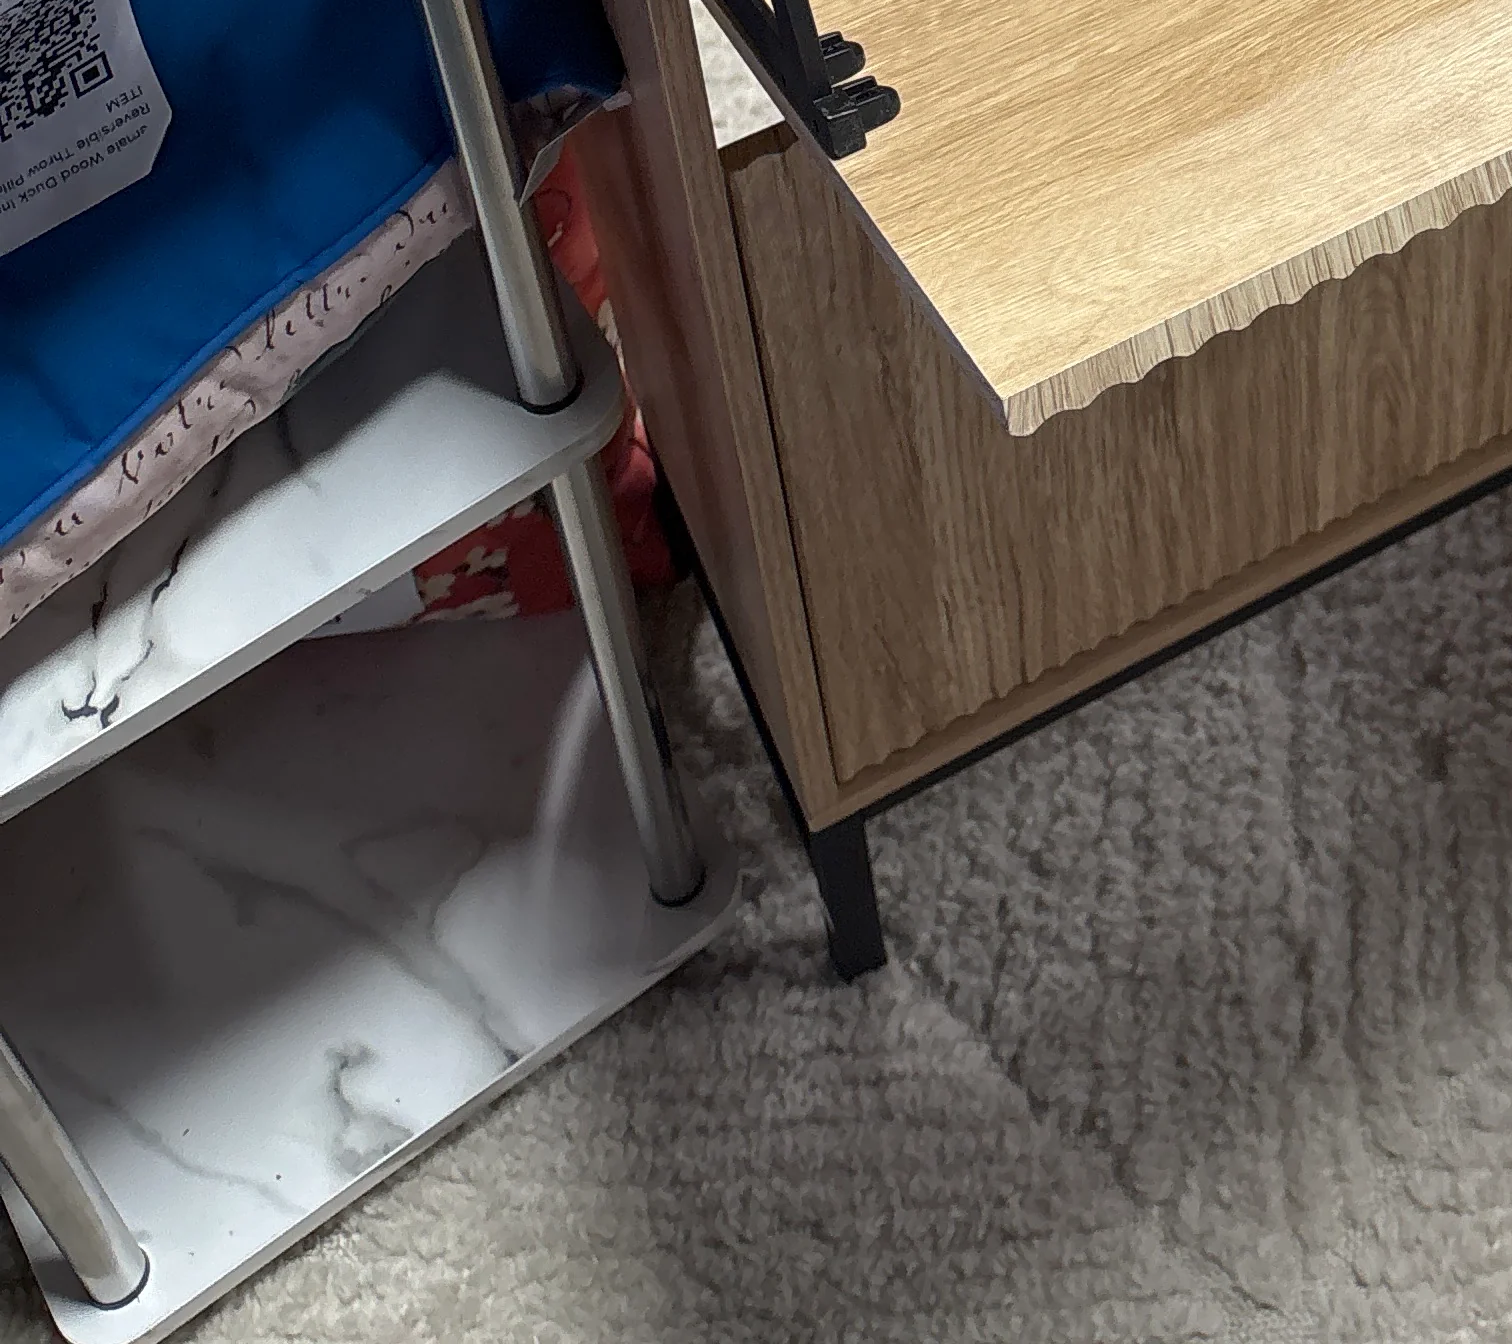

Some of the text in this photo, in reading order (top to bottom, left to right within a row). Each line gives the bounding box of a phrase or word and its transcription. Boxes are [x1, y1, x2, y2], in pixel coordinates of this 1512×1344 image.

[106, 85, 144, 113] ITEM
[76, 102, 151, 150] Reversible
[28, 147, 75, 177] Throw
[60, 151, 105, 183] Wood
[18, 175, 59, 203] Duck
[0, 198, 17, 212] In
